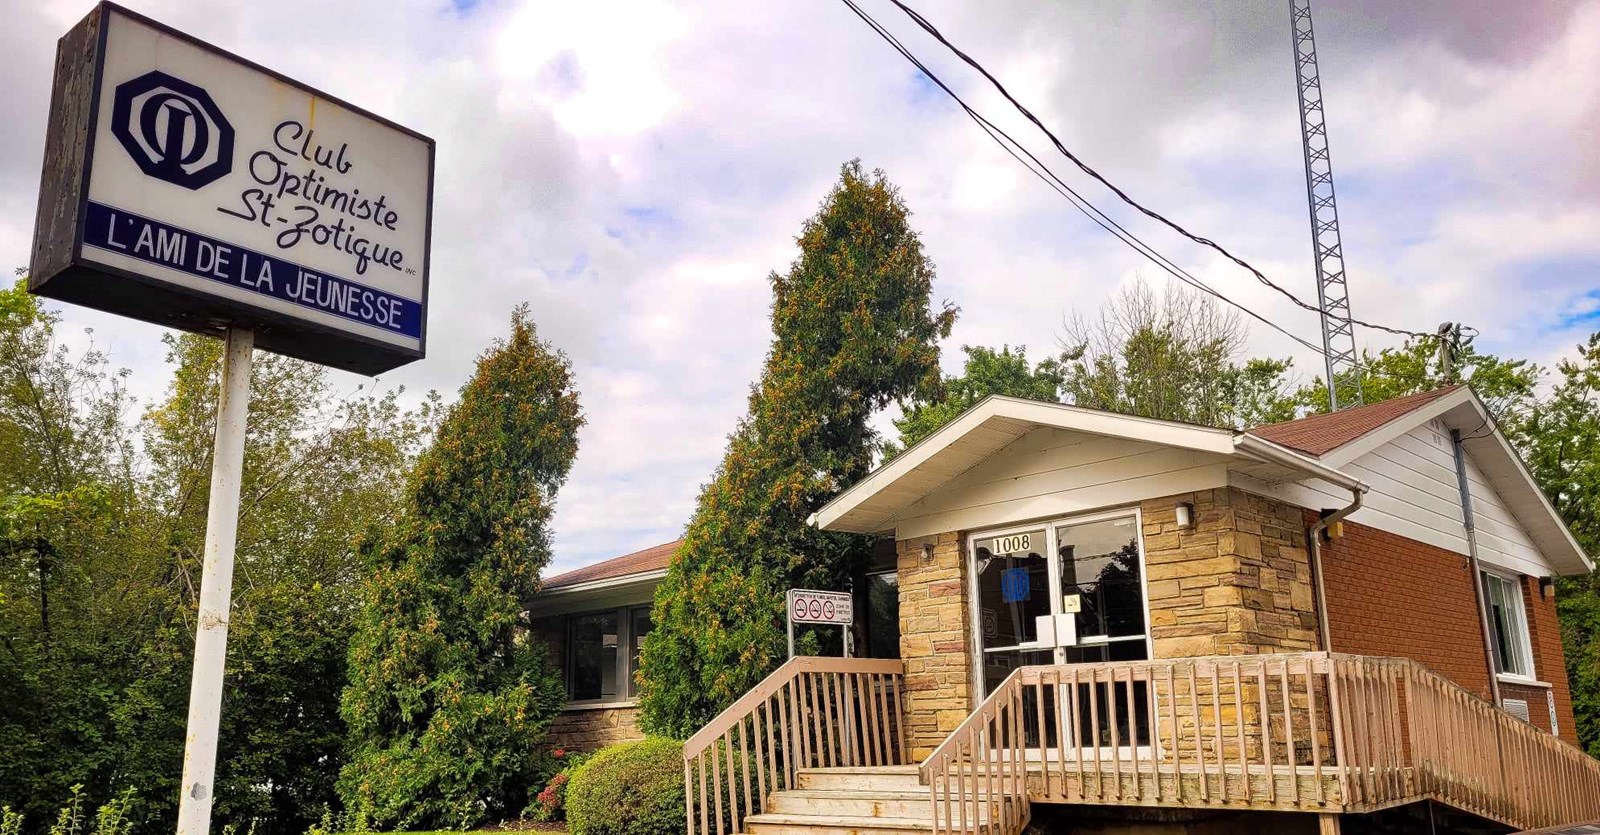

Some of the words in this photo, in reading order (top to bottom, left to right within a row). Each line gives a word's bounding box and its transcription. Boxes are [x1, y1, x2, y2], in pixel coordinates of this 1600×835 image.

[273, 120, 352, 174] Club
[249, 150, 398, 231] Optimiste
[107, 213, 187, 266] L'AMI
[196, 240, 232, 278] DE
[240, 253, 274, 292] LA
[285, 271, 403, 329] JEUNESSE
[217, 189, 403, 275] St-Zotique
[995, 535, 1030, 553] 1008
